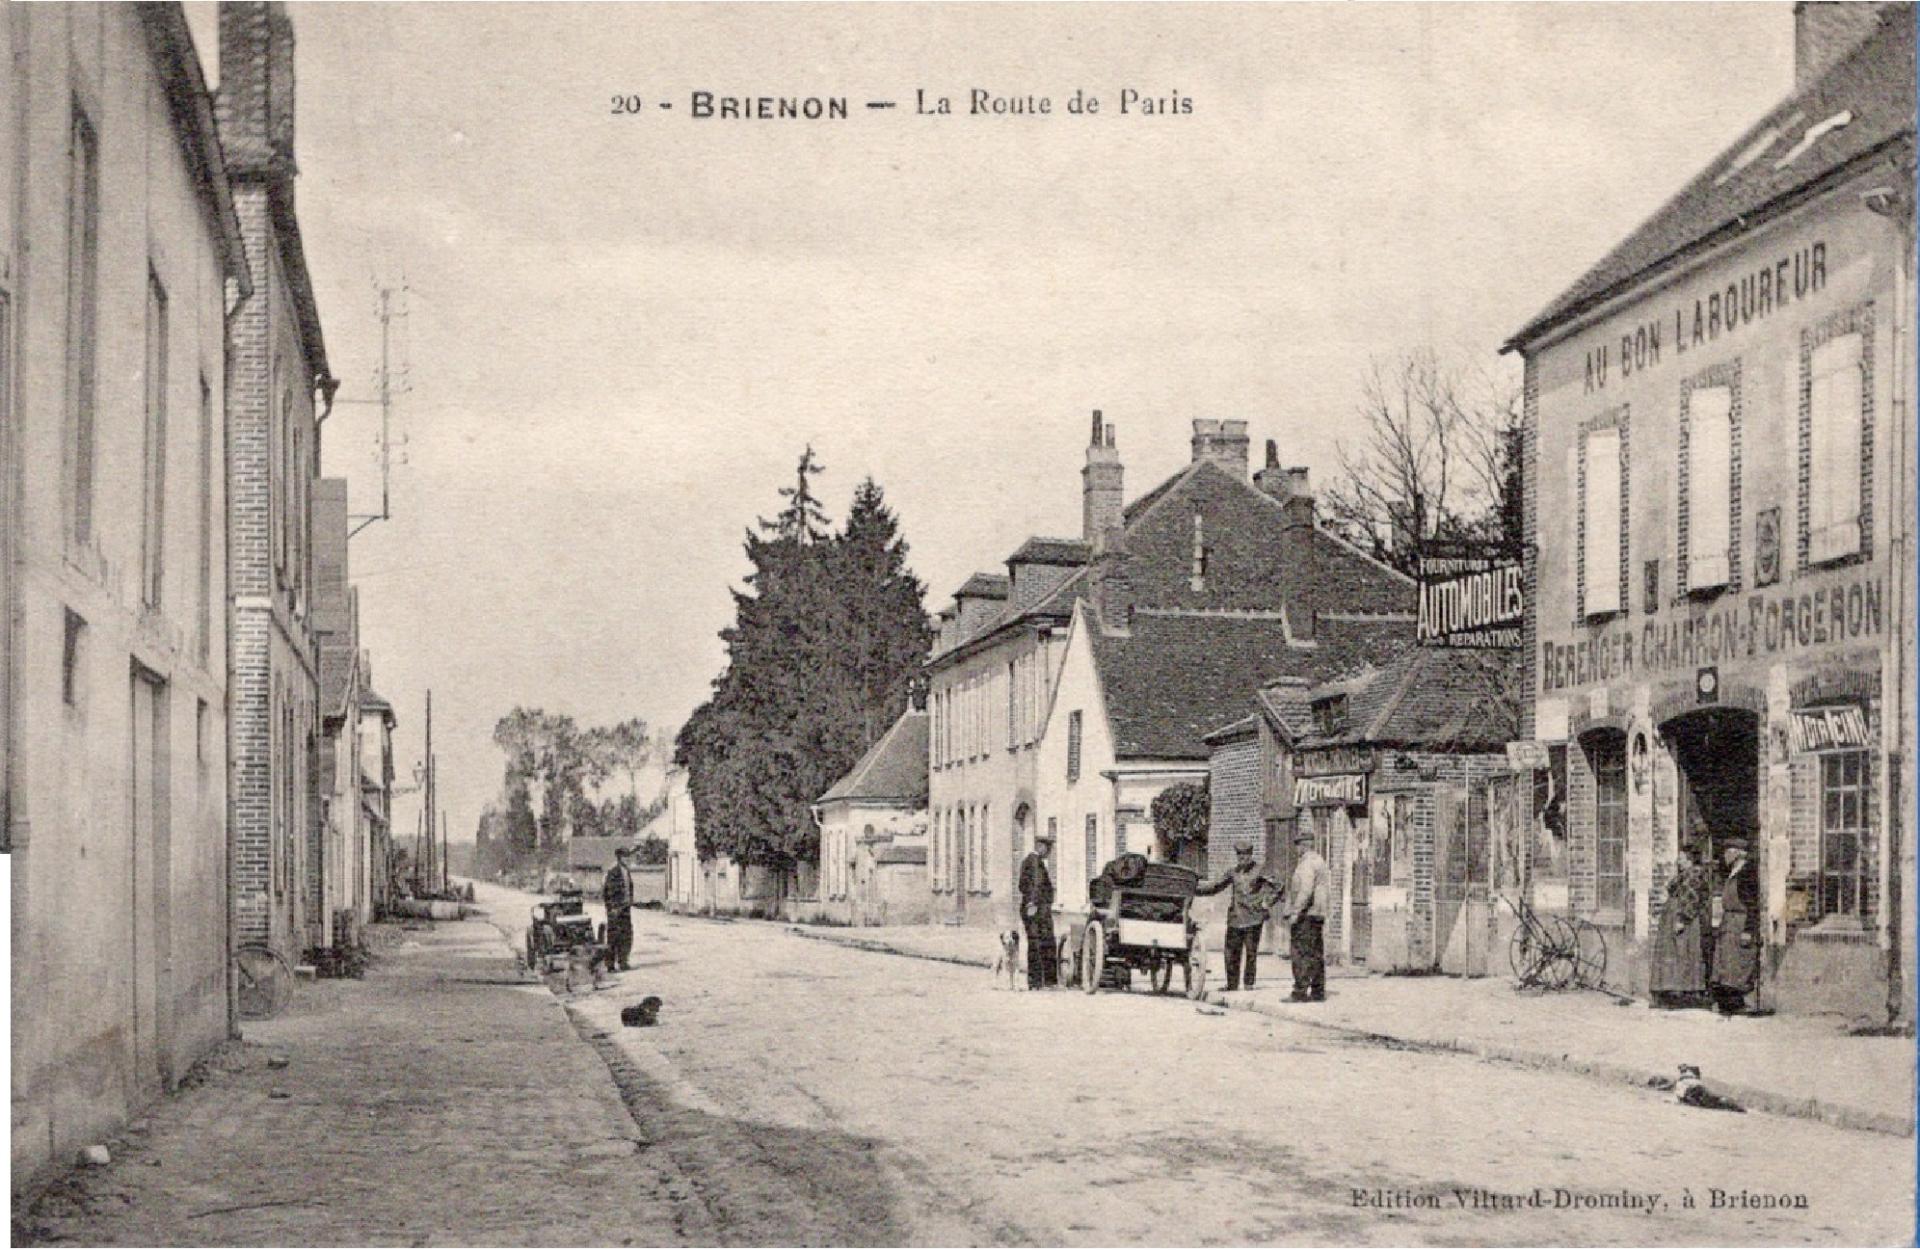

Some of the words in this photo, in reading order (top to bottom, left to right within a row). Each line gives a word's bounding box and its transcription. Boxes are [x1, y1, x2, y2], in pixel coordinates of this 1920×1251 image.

[1584, 345, 1607, 396] AU
[1621, 319, 1661, 378] BON
[1676, 240, 1826, 355] LABOUREUR
[1417, 566, 1523, 641] AUTOMOBILES
